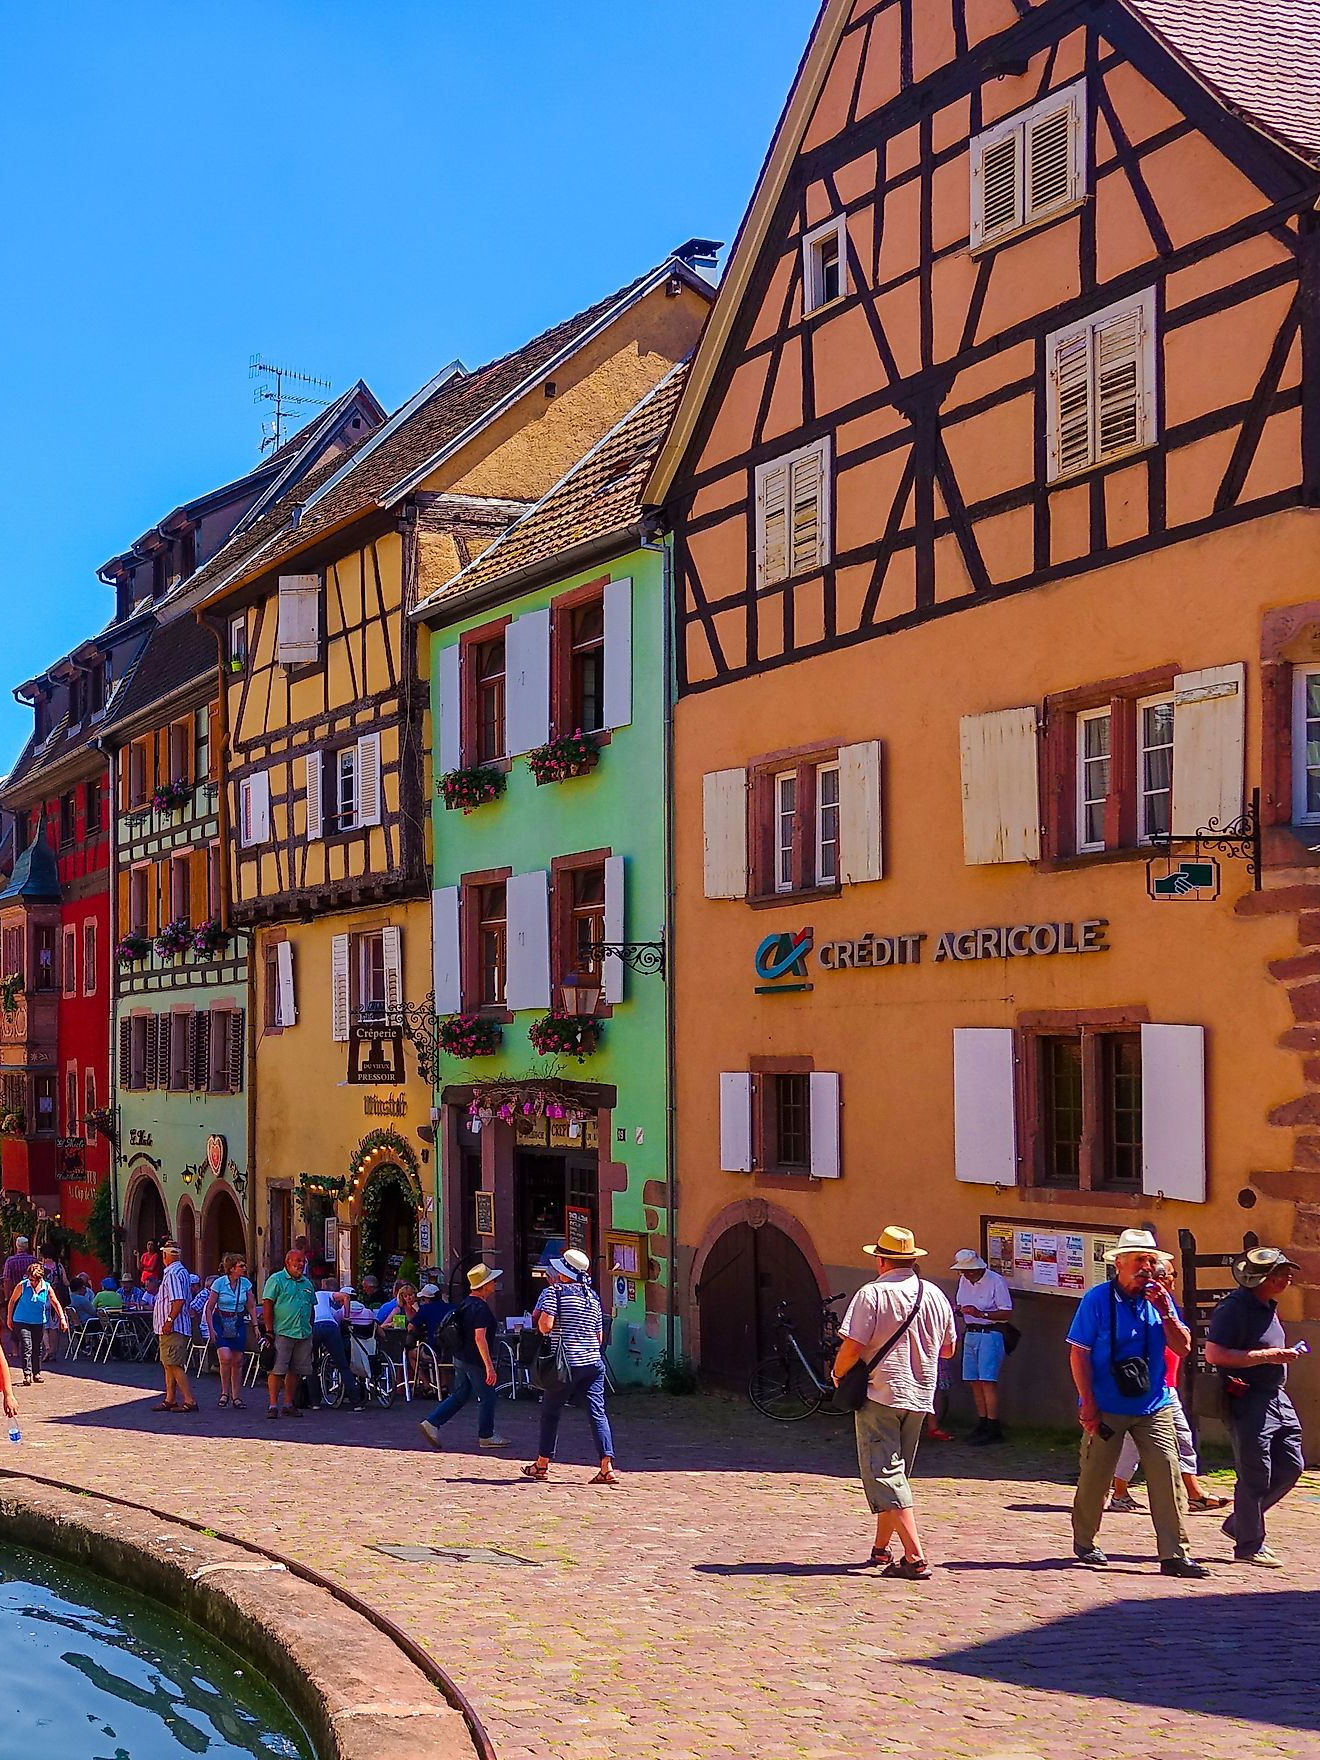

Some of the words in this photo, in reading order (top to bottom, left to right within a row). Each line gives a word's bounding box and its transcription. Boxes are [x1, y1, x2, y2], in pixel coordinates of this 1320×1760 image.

[818, 933, 927, 969] CRÉDIT
[933, 919, 1110, 963] AGRICOLE
[356, 1028, 397, 1039] Crêperie
[357, 1073, 396, 1081] PRESSOIR
